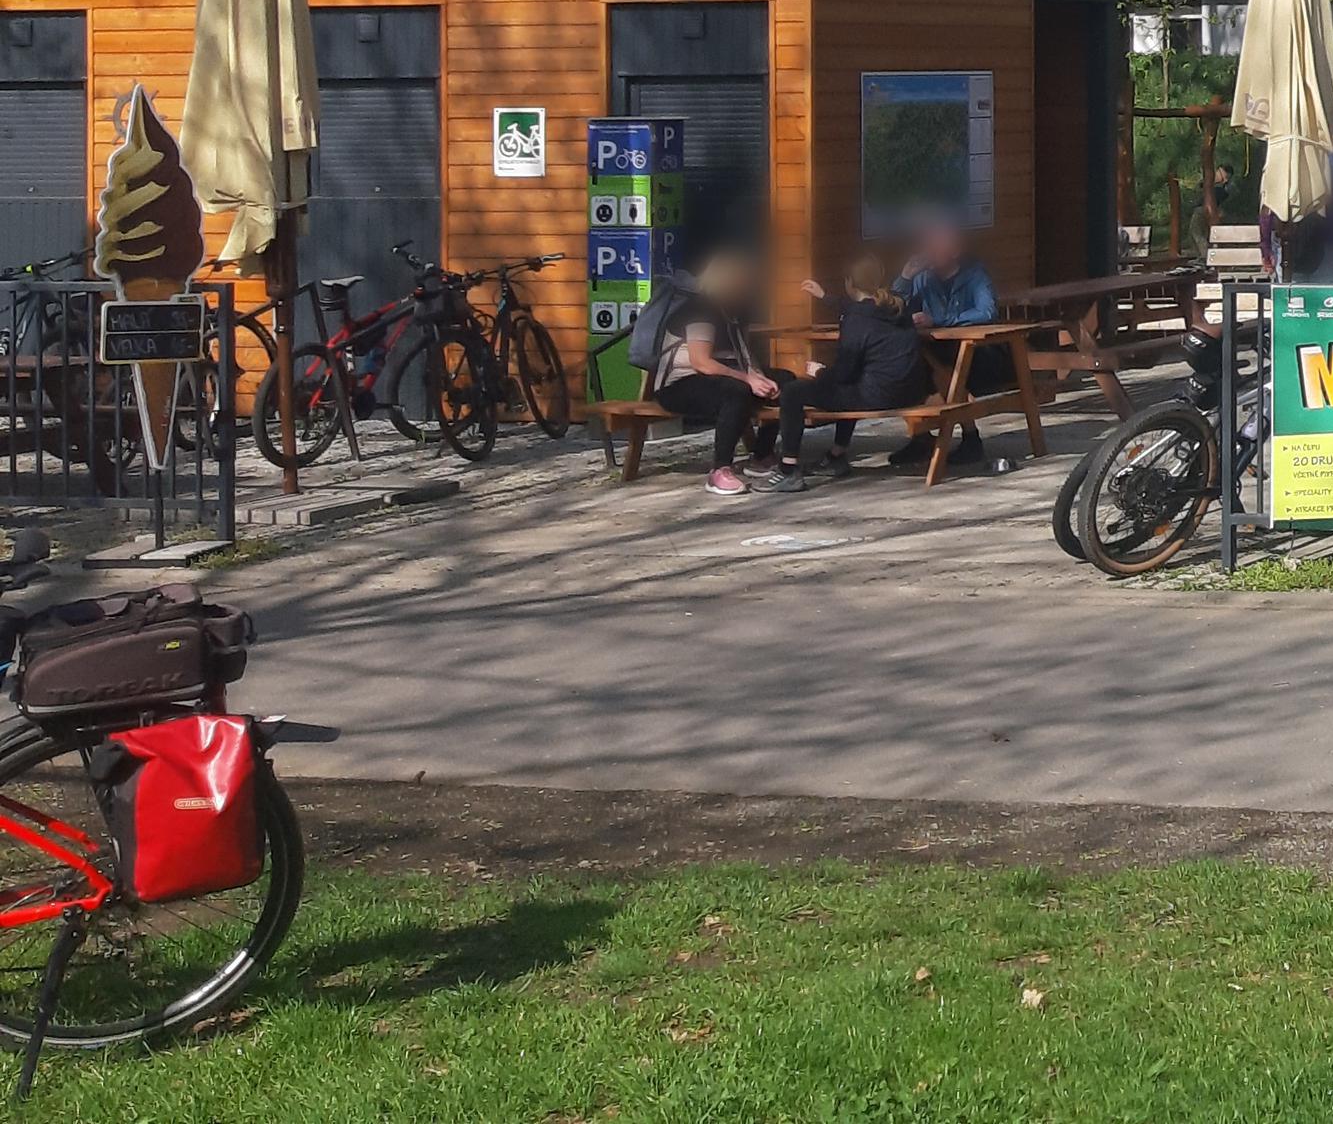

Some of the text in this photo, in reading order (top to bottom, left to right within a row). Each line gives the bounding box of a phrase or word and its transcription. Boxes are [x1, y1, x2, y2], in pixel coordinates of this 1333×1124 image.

[664, 127, 675, 149] P
[597, 140, 617, 170] P
[596, 246, 617, 276] P
[1293, 457, 1309, 467] 20
